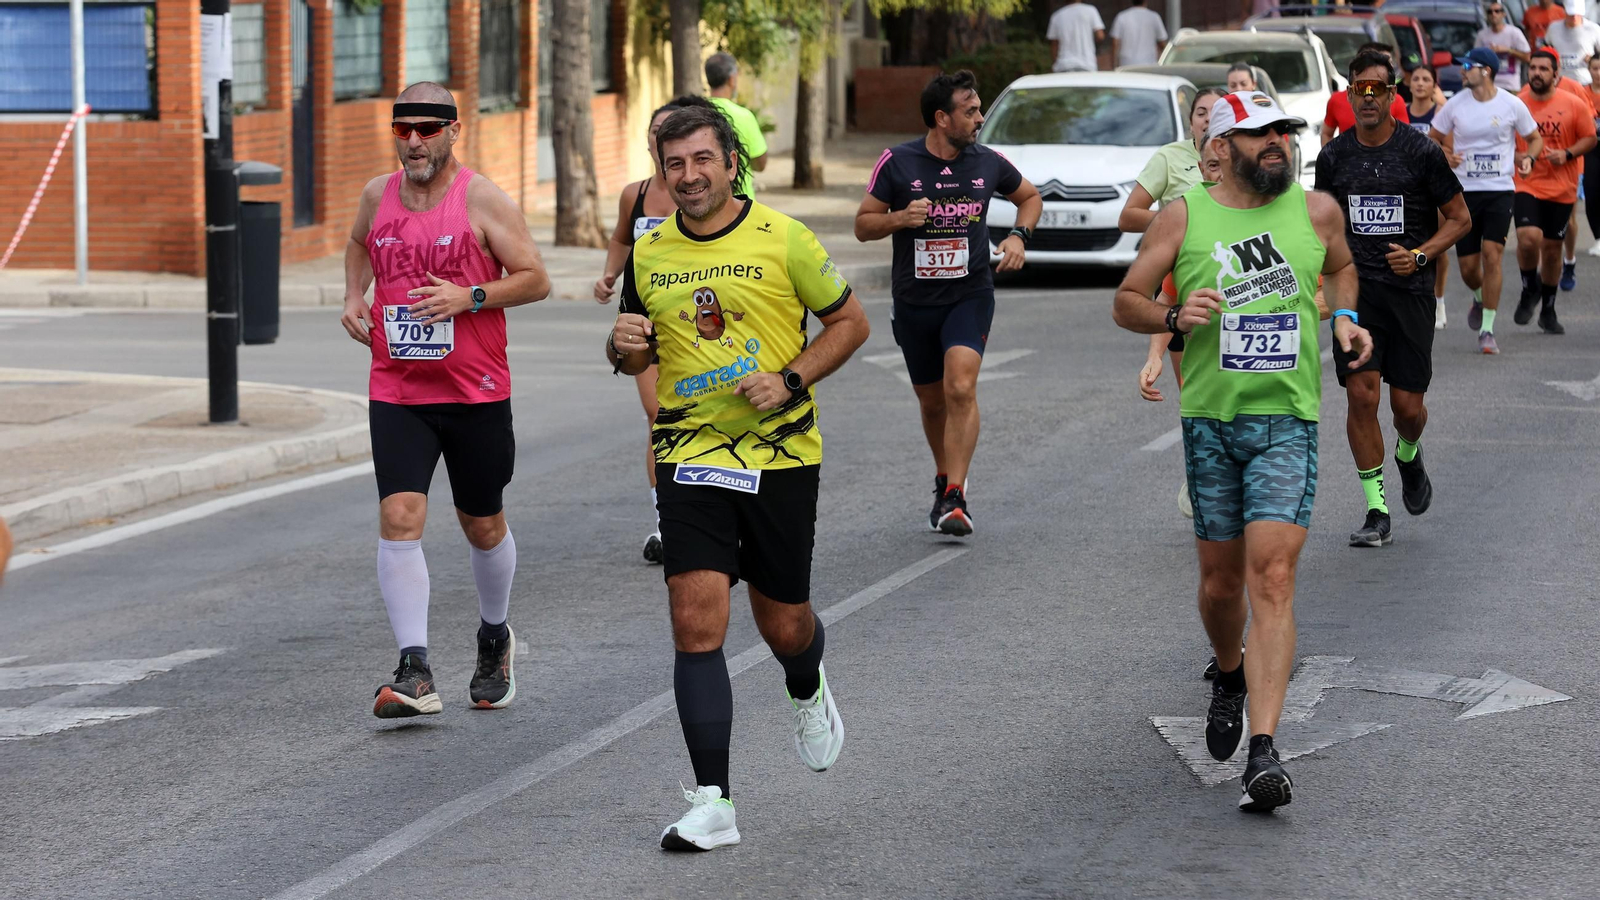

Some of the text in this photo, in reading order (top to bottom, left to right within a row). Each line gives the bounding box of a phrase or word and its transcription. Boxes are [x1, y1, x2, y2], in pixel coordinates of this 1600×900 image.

[1475, 161, 1493, 170] 765
[933, 216, 970, 228] CIELO
[1358, 208, 1395, 222] 1047
[927, 252, 956, 266] 317
[1230, 233, 1286, 273] XX
[650, 263, 763, 290] Paparunners
[1223, 281, 1252, 300] MEDIO
[1279, 282, 1298, 299] 2017
[398, 323, 435, 342] 709
[1241, 334, 1281, 353] 732
[1249, 359, 1293, 369] MIZUNO
[674, 354, 759, 398] agarrado
[694, 386, 718, 397] OBRAS
[703, 471, 752, 489] MIZUNO
